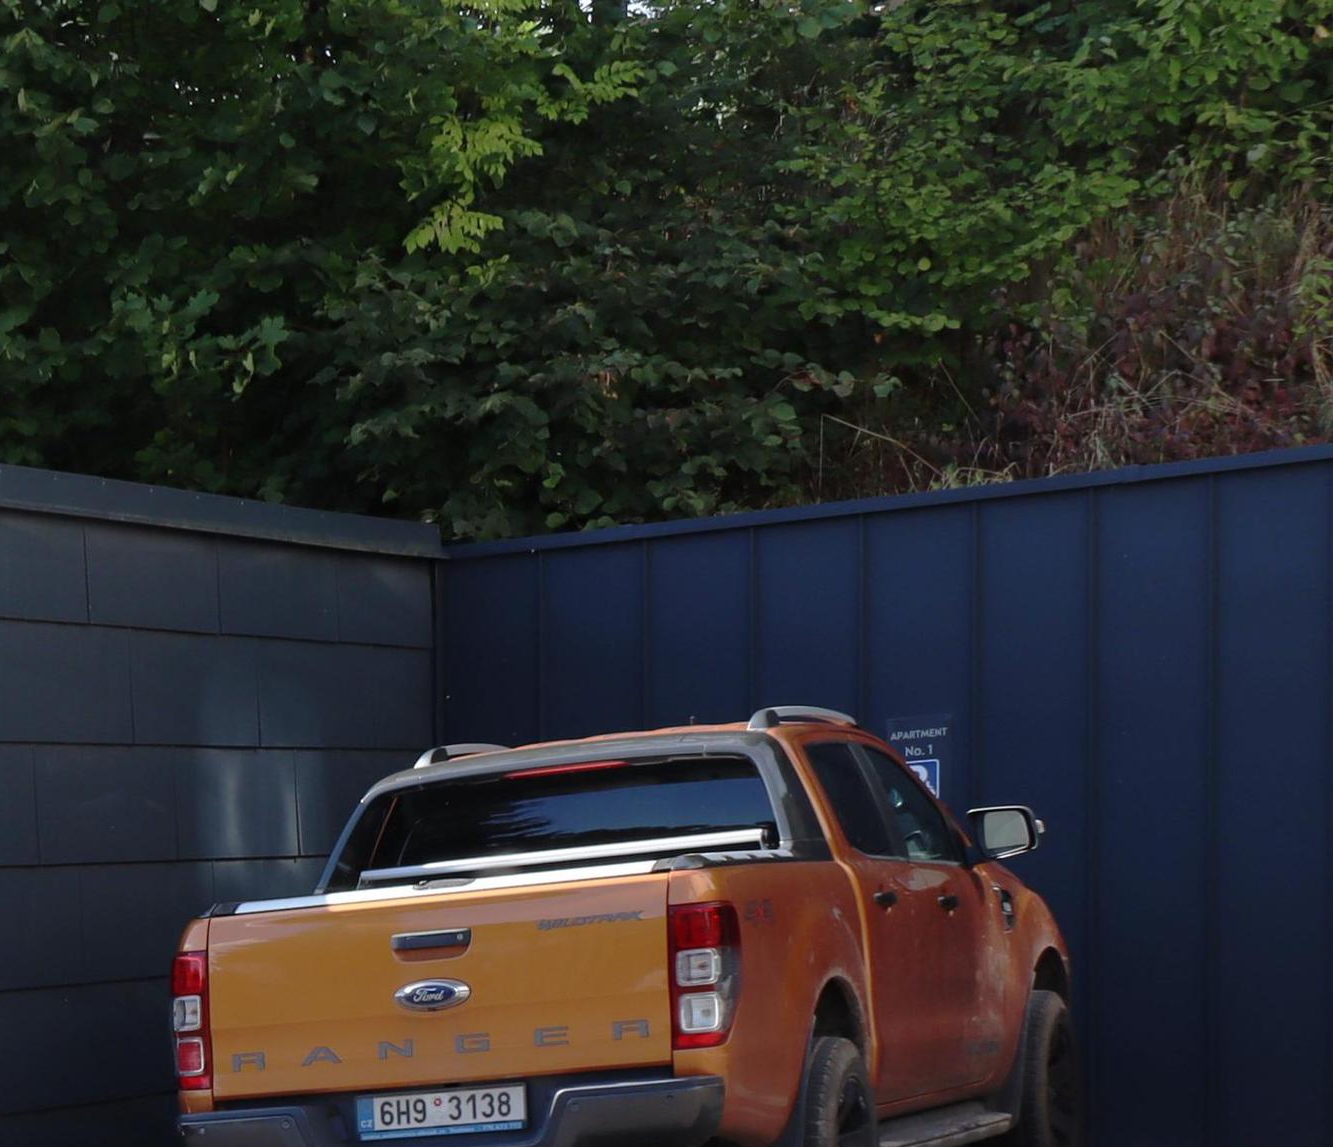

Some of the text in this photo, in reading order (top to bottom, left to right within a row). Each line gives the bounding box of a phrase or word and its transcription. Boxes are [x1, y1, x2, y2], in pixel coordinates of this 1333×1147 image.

[890, 728, 947, 740] APARTMENT
[905, 746, 925, 756] No.
[413, 987, 445, 1003] Ford
[232, 1018, 651, 1073] RANGER
[380, 1091, 512, 1126] 6H9 3138
[360, 1120, 373, 1129] CZ
